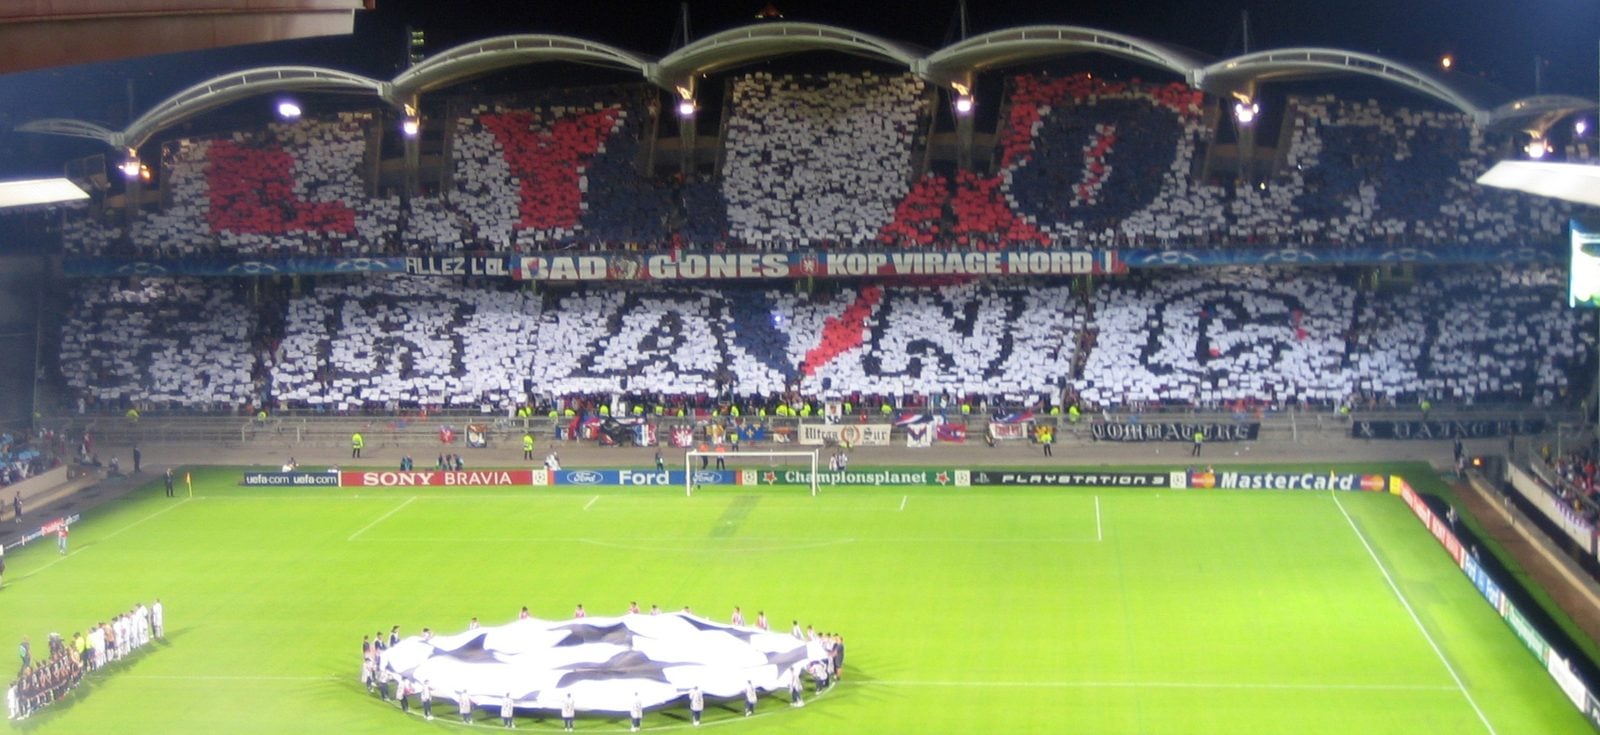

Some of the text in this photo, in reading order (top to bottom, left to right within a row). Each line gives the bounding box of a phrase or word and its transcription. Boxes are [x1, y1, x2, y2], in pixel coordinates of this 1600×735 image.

[406, 257, 509, 275] ALLEZ L'OL
[521, 252, 1093, 280] BAD GONES KOP VIRAGE NORD
[363, 472, 512, 486] SONY BRAVIA
[619, 470, 669, 485] Ford
[785, 470, 927, 486] Championsplanet
[1152, 476, 1165, 484] 3
[1221, 472, 1353, 491] MasterCard
